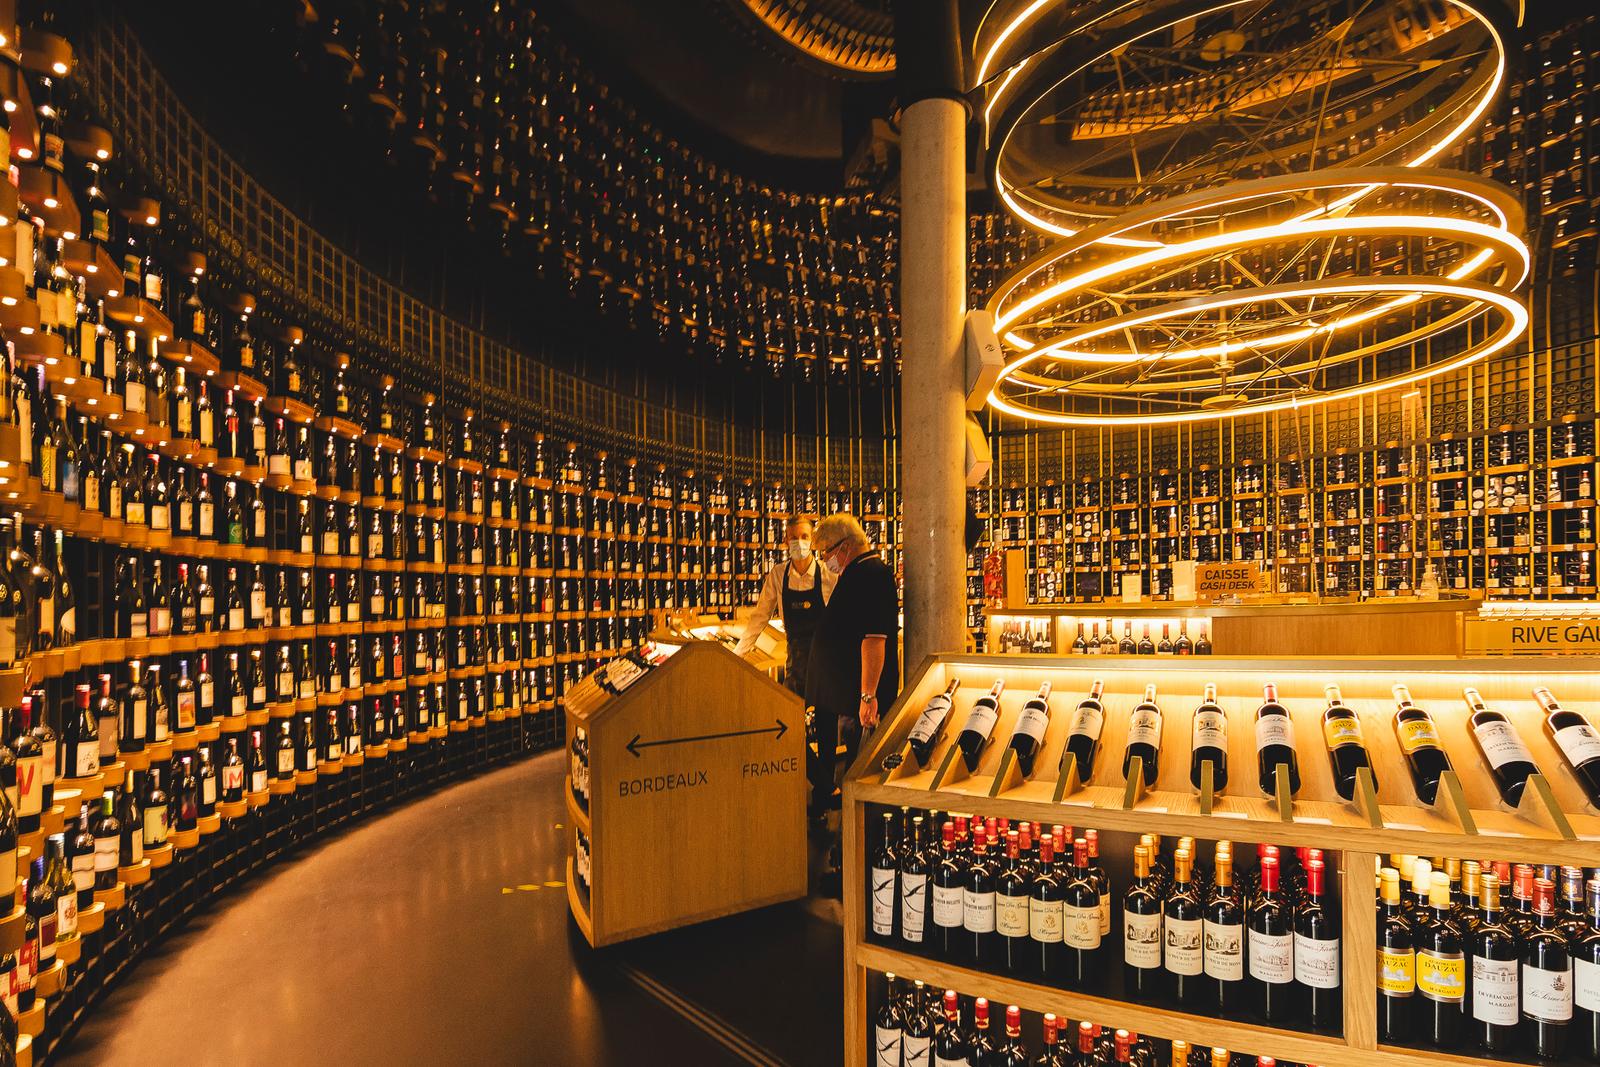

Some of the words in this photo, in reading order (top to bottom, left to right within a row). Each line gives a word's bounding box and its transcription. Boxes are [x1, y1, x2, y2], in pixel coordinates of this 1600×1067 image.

[1205, 569, 1249, 580] CAISSE
[1200, 581, 1226, 590] CASH
[1228, 580, 1256, 590] DESK
[1512, 626, 1559, 643] RIVE
[741, 757, 798, 779] FRANCE
[619, 769, 708, 798] BORDEAUX
[1424, 961, 1459, 973] DAUZAC
